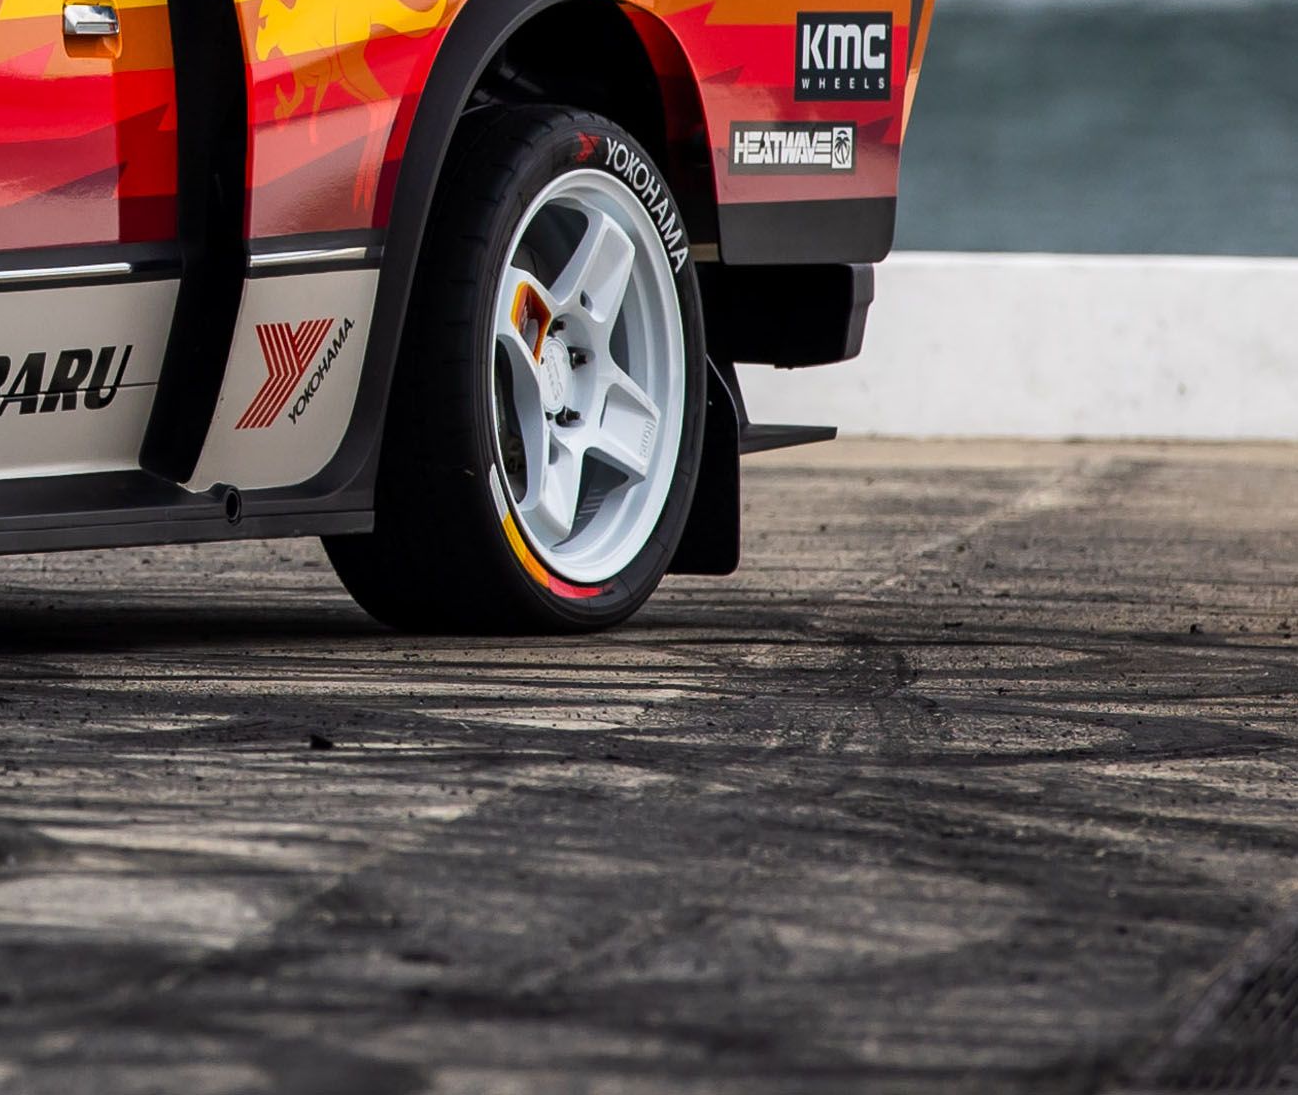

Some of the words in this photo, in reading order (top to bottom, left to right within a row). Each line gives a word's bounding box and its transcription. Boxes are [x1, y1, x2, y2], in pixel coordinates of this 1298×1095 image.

[801, 23, 887, 70] KMC
[801, 77, 886, 90] WHEELS
[733, 130, 834, 165] HEATWAVE
[605, 135, 690, 275] YOKOHAMA
[287, 316, 355, 425] YOKOHAMA
